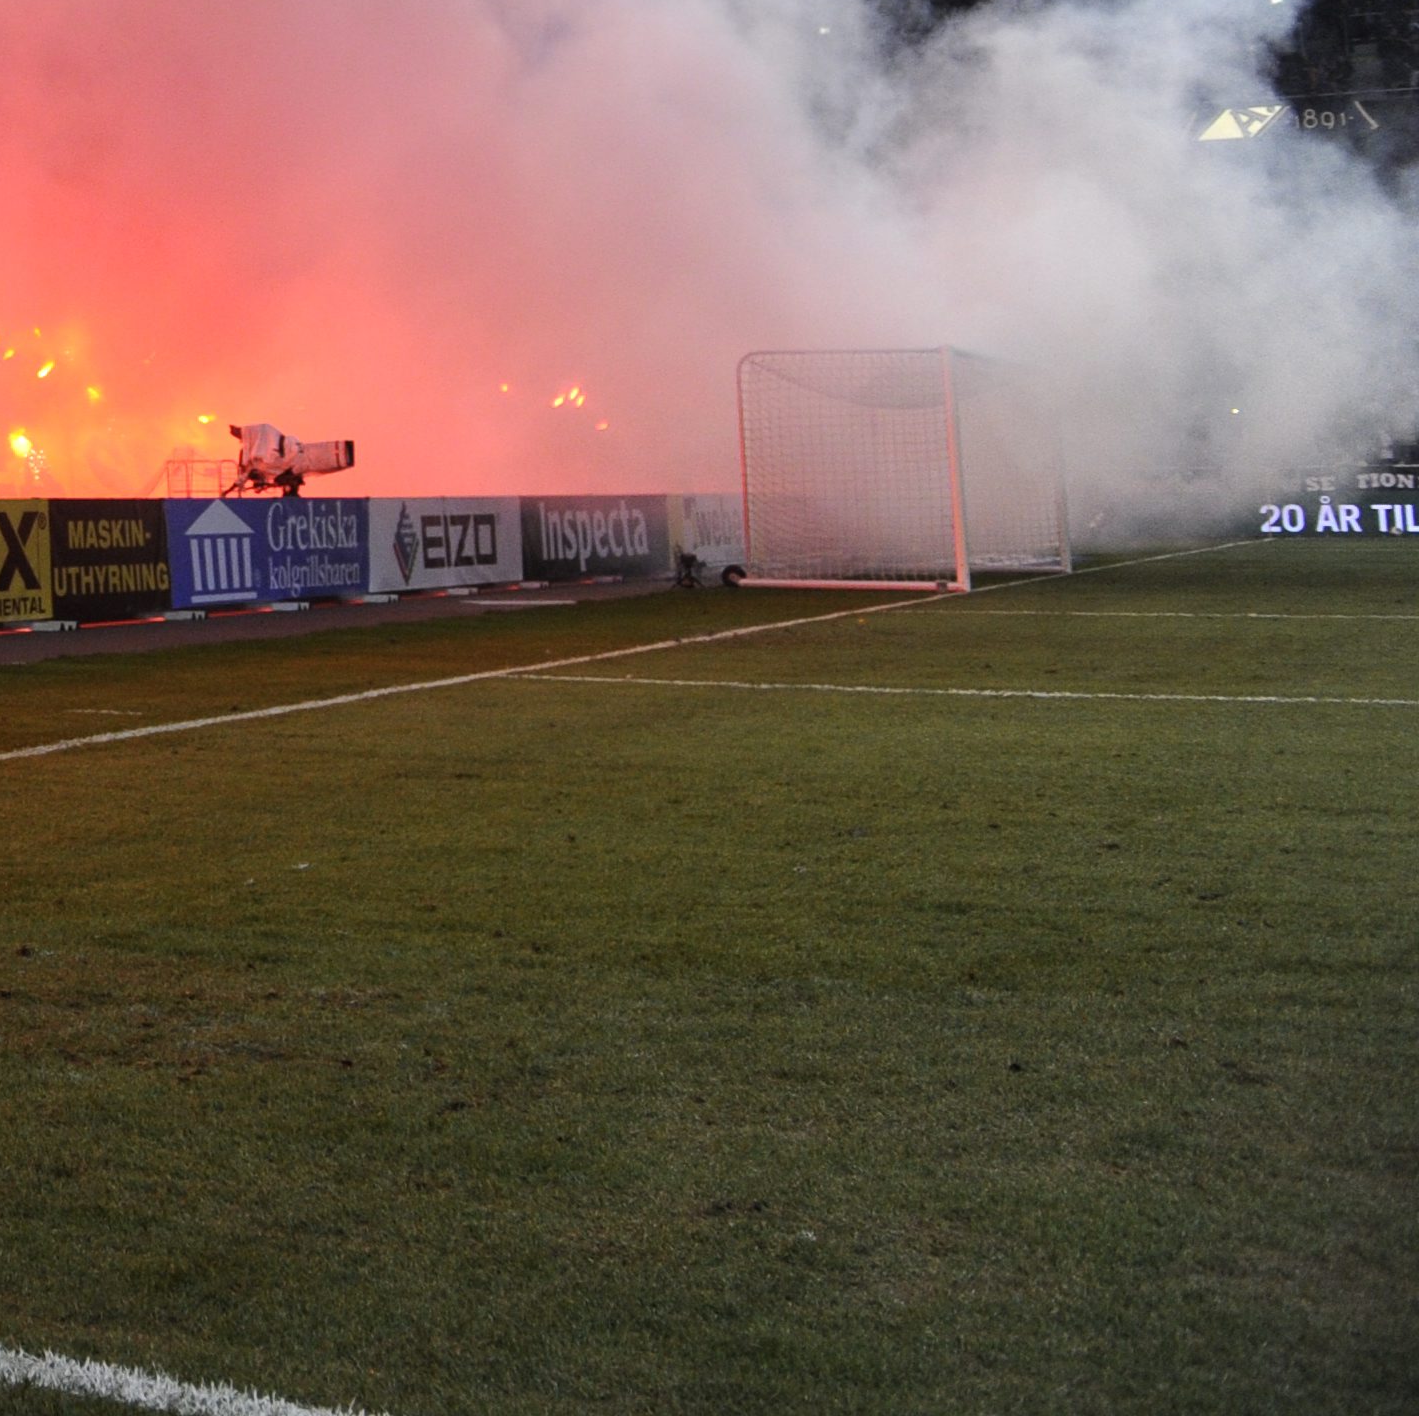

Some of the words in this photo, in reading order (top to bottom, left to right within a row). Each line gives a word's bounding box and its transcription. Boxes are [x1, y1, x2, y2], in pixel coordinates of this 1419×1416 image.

[68, 519, 151, 549] MASKIN-
[267, 501, 358, 551] Grekiska
[539, 500, 649, 572] Inspecta
[1259, 504, 1305, 533] 20
[1316, 495, 1363, 533] ÅR
[420, 513, 497, 568] EIZO
[53, 562, 170, 596] UTHYRNING
